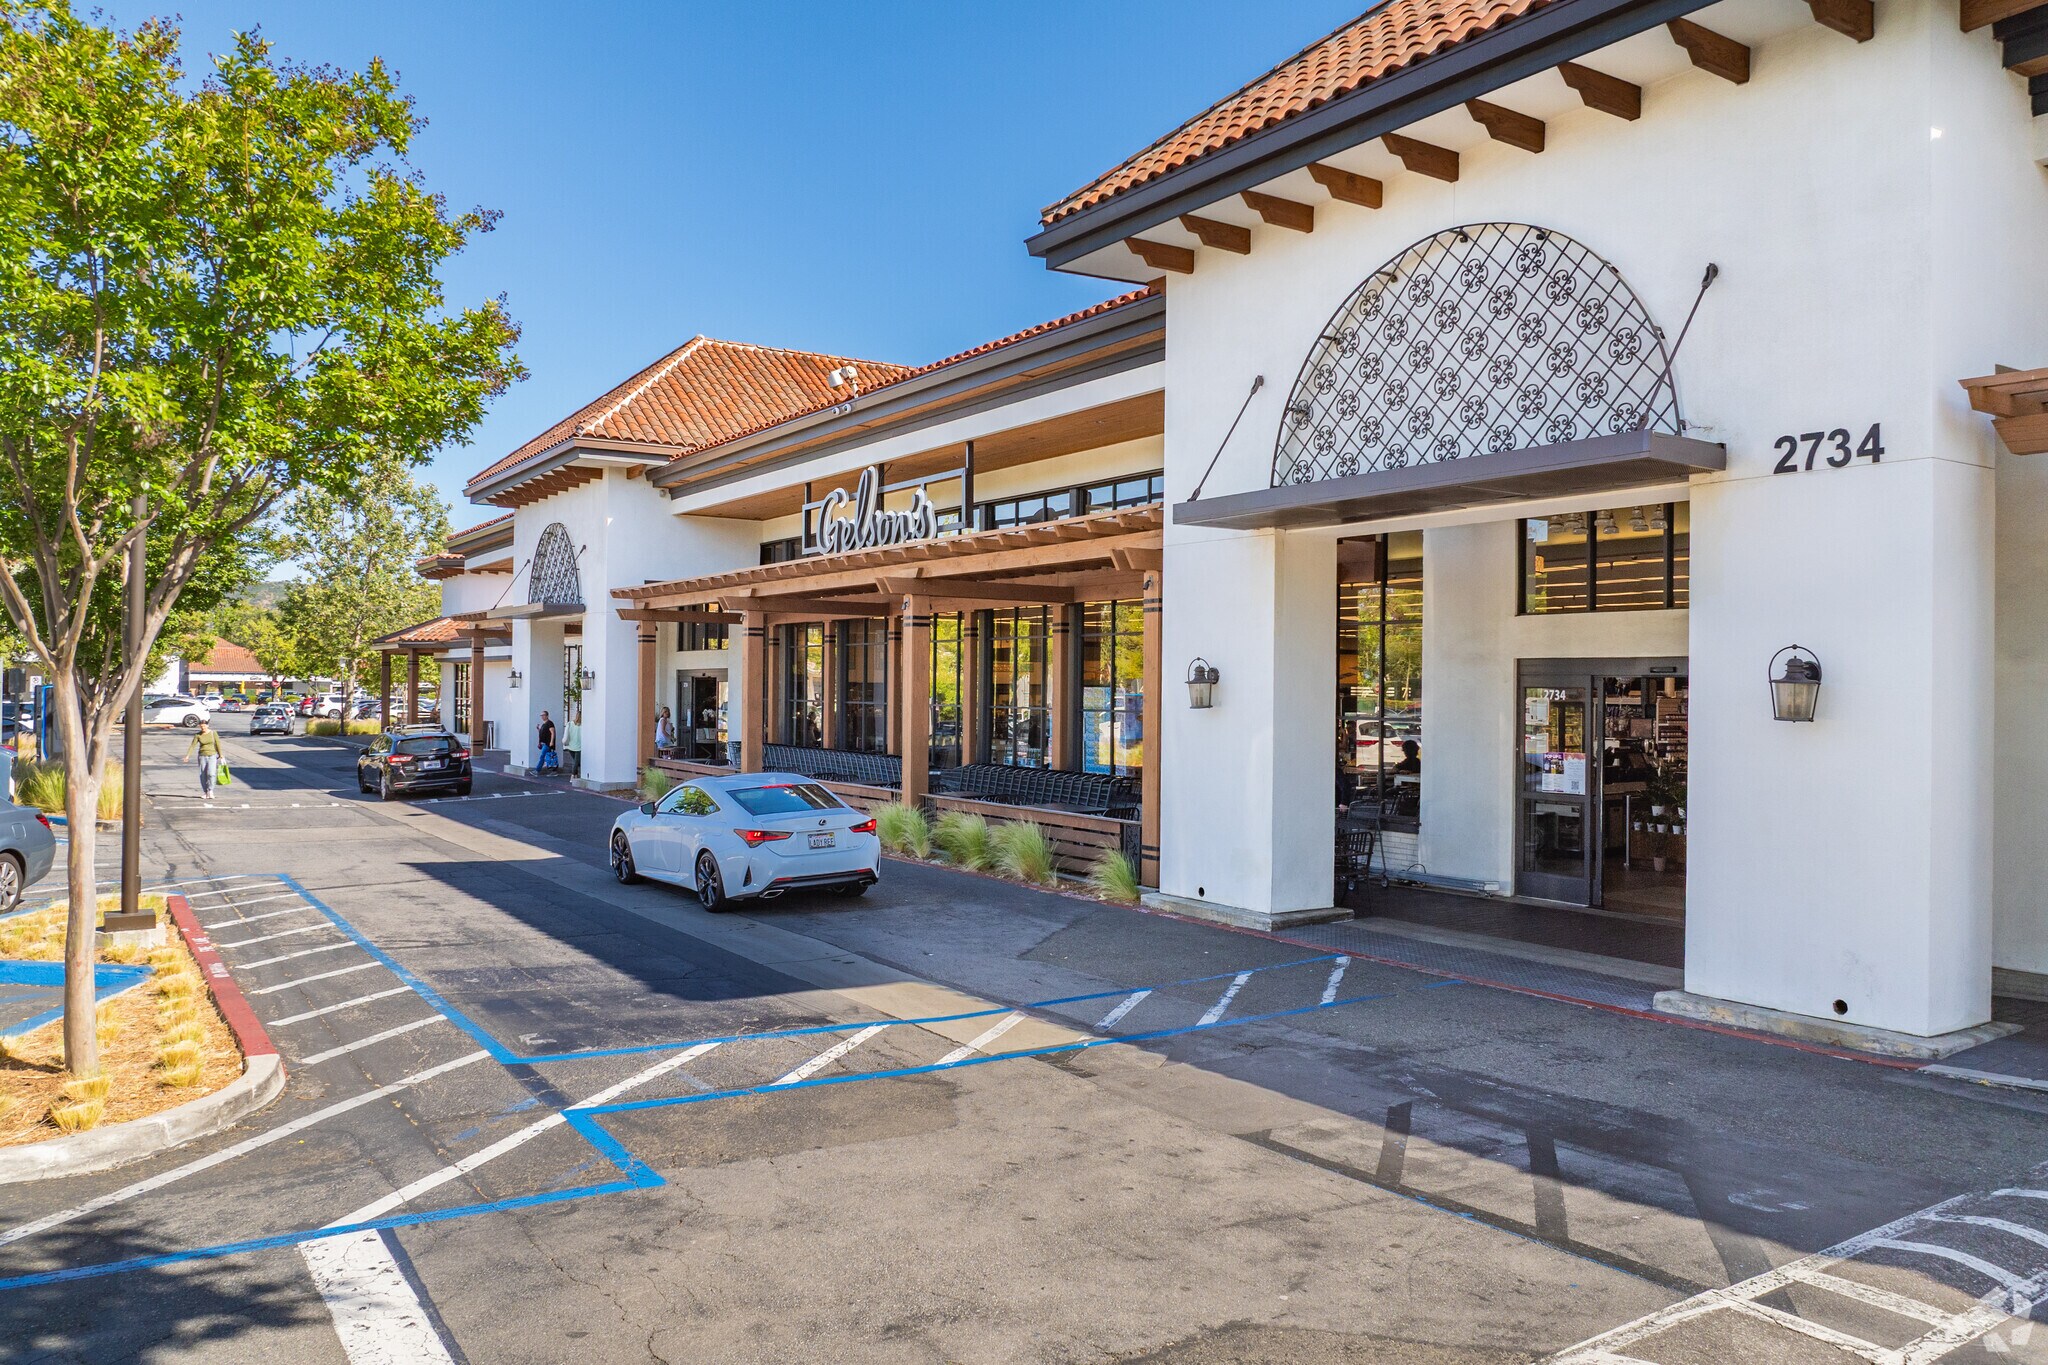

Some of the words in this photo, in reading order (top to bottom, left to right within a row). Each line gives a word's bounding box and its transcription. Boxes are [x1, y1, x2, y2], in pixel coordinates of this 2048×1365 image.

[1773, 423, 1885, 474] 2734
[816, 466, 938, 555] Gelson's
[1543, 689, 1566, 700] 2734
